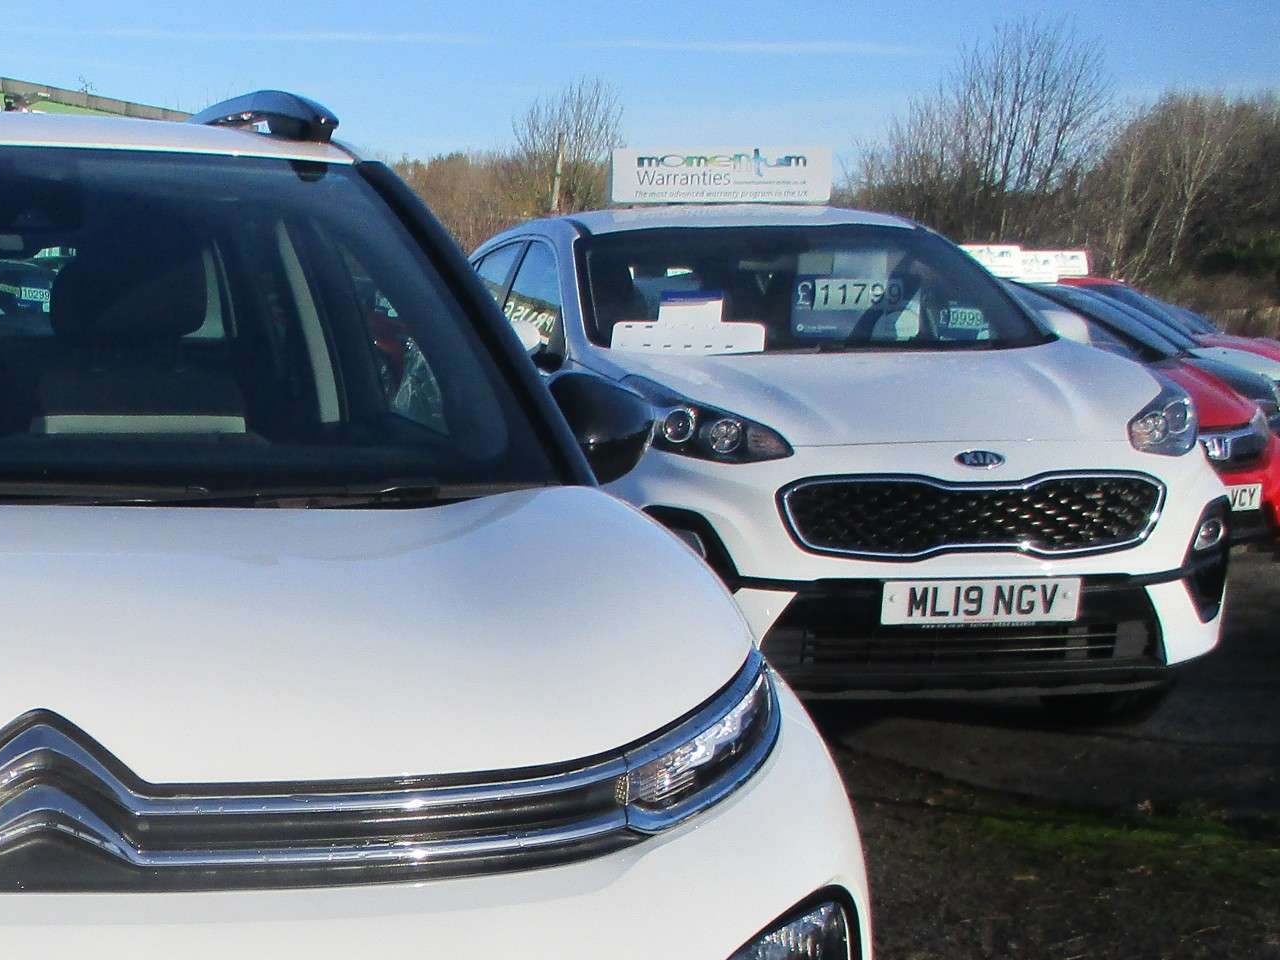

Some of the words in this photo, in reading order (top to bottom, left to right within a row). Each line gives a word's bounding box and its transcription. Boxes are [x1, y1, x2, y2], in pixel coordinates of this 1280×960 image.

[637, 148, 807, 177] momentum
[637, 169, 731, 186] Warranties
[963, 452, 999, 465] KIA
[1231, 487, 1256, 507] VCY
[907, 586, 984, 617] ML19
[993, 584, 1058, 616] NGV
